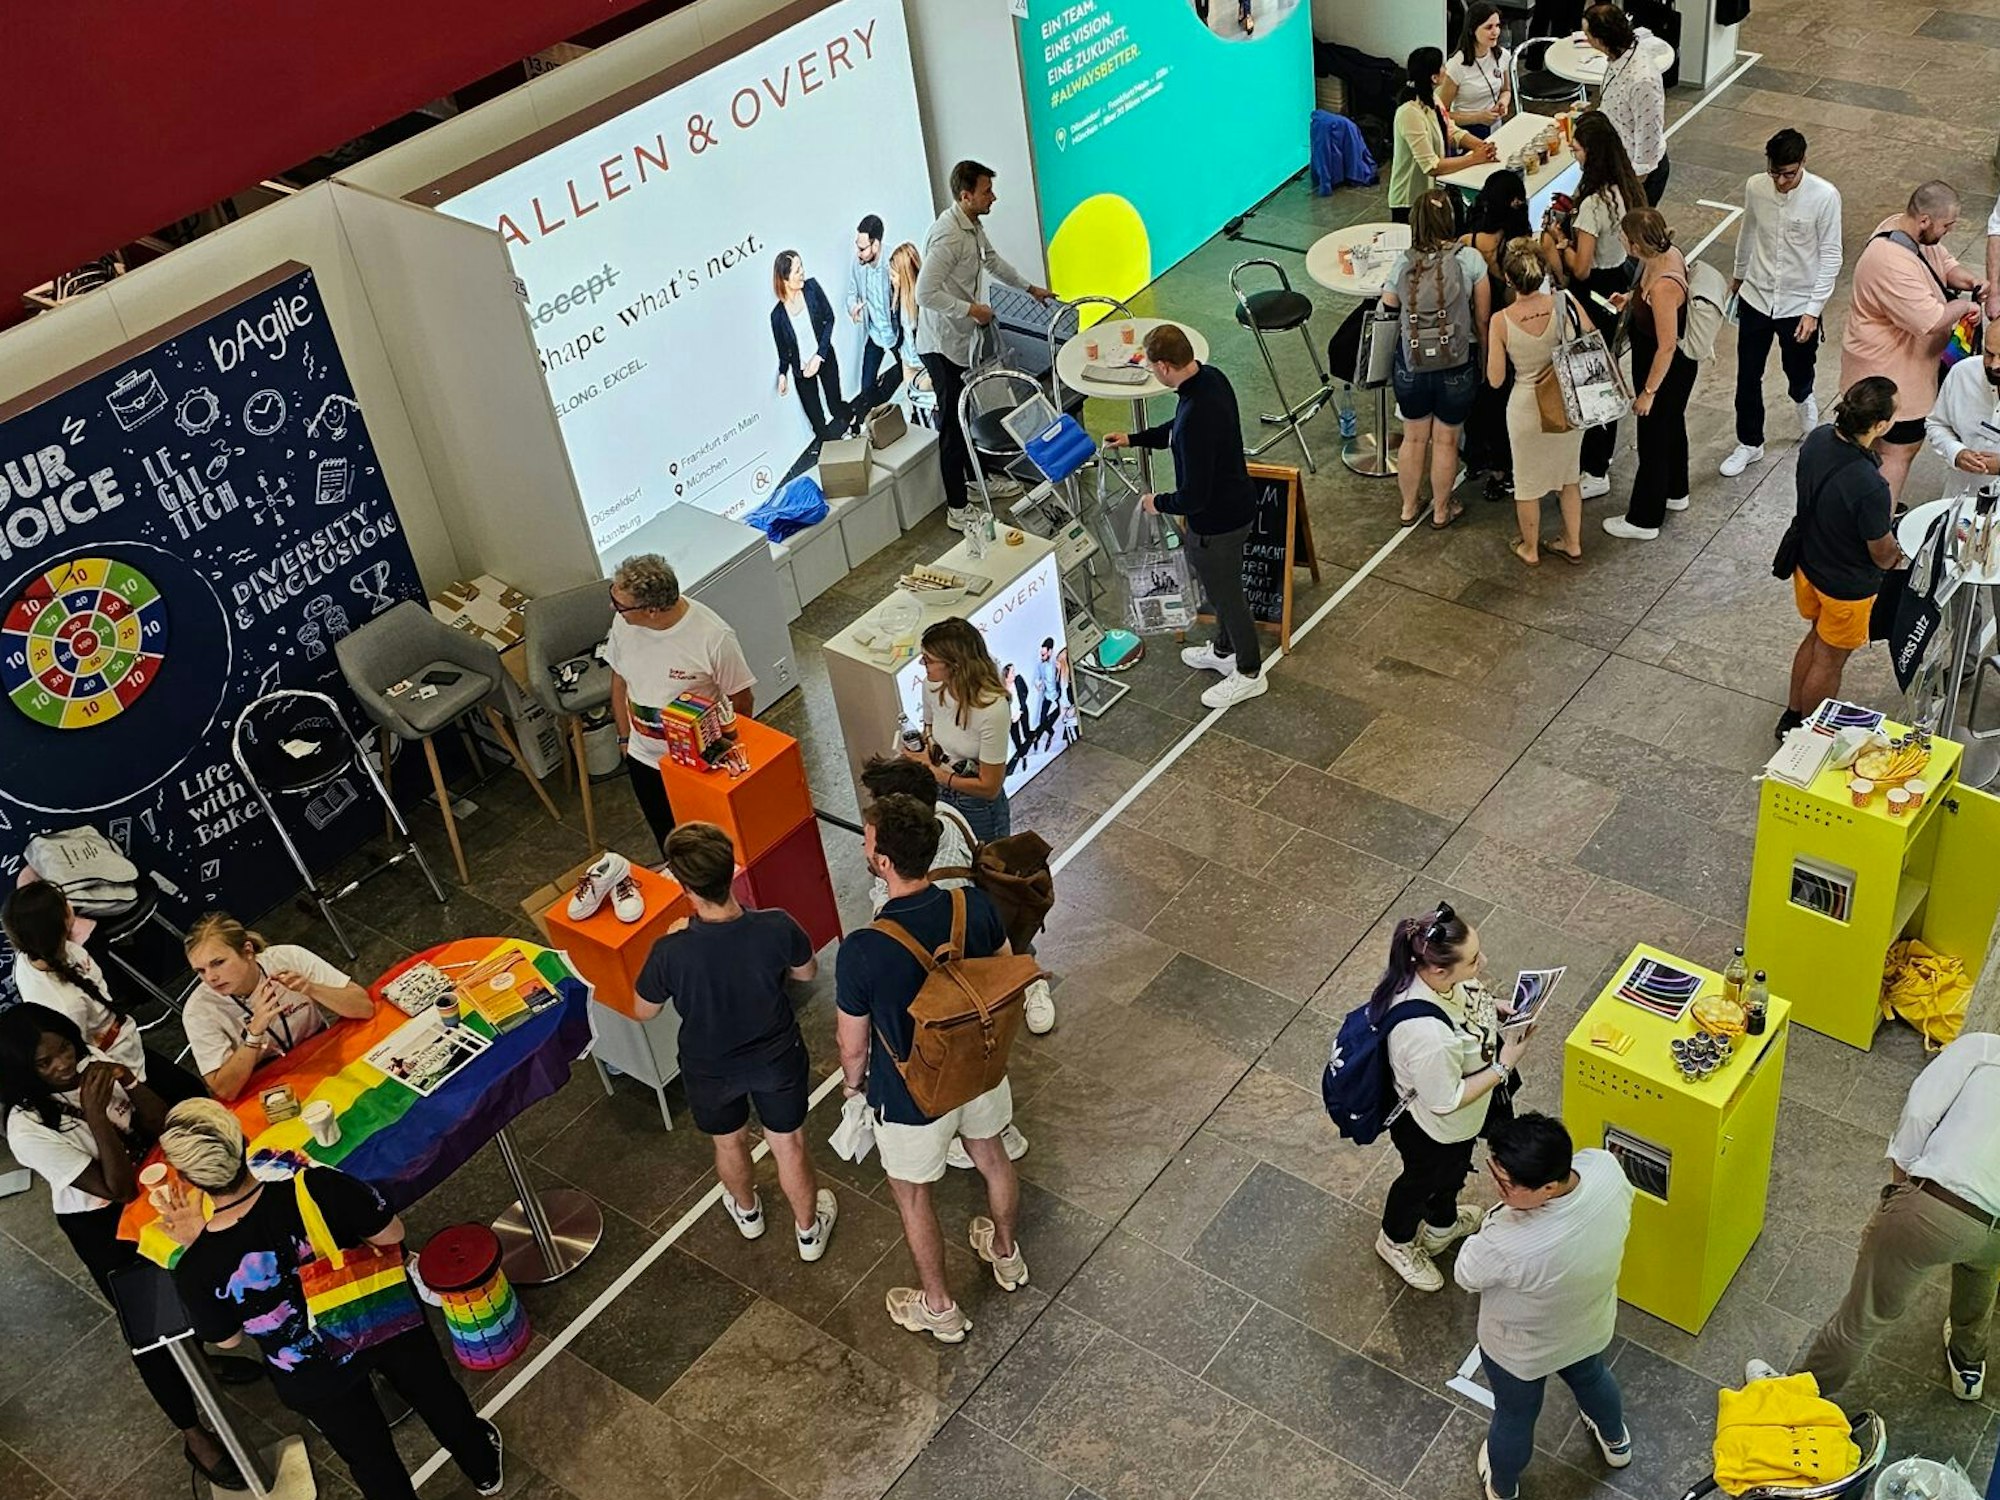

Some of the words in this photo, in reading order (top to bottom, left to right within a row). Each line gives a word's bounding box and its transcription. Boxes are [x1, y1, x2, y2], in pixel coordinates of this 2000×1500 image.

[1041, 16, 1061, 40] EIN
[1062, 0, 1098, 26] TEAM.
[1044, 35, 1071, 63] EINE
[1072, 11, 1114, 45] VISION.
[1047, 58, 1074, 86] EINE
[1074, 26, 1129, 69] ZUKUNFT.
[1051, 44, 1141, 109] #ALWAYSBETTER.
[498, 134, 670, 248] ALLEN
[687, 113, 720, 155] &
[731, 18, 877, 129] OVERY
[616, 267, 699, 330] what's
[705, 231, 764, 280] next.
[531, 263, 621, 330] ccept
[208, 294, 313, 373] bAgile
[603, 358, 648, 390] EXCEL.
[0, 444, 76, 511] UR
[169, 480, 240, 540] TECH
[231, 502, 369, 606] DIVERSITY
[71, 568, 88, 585] 10
[235, 606, 255, 630] &
[258, 512, 397, 614] INCLUSION
[75, 595, 88, 608] 40
[120, 578, 139, 596] 10
[993, 570, 1047, 624] OVERY
[21, 599, 41, 617] 10
[45, 615, 58, 628] 30
[107, 601, 121, 614] 50
[121, 628, 134, 640] 20
[143, 620, 161, 637] 10
[1907, 614, 1930, 643] Lutz
[6, 651, 25, 669] 10
[35, 648, 48, 661] 20
[111, 660, 125, 673] 50
[51, 674, 64, 688] 30
[83, 678, 96, 691] 40
[127, 670, 145, 688] 10
[31, 693, 50, 710] 10
[82, 700, 100, 717] 10
[179, 762, 233, 801] Life
[188, 781, 247, 822] with
[193, 801, 264, 847] Bake
